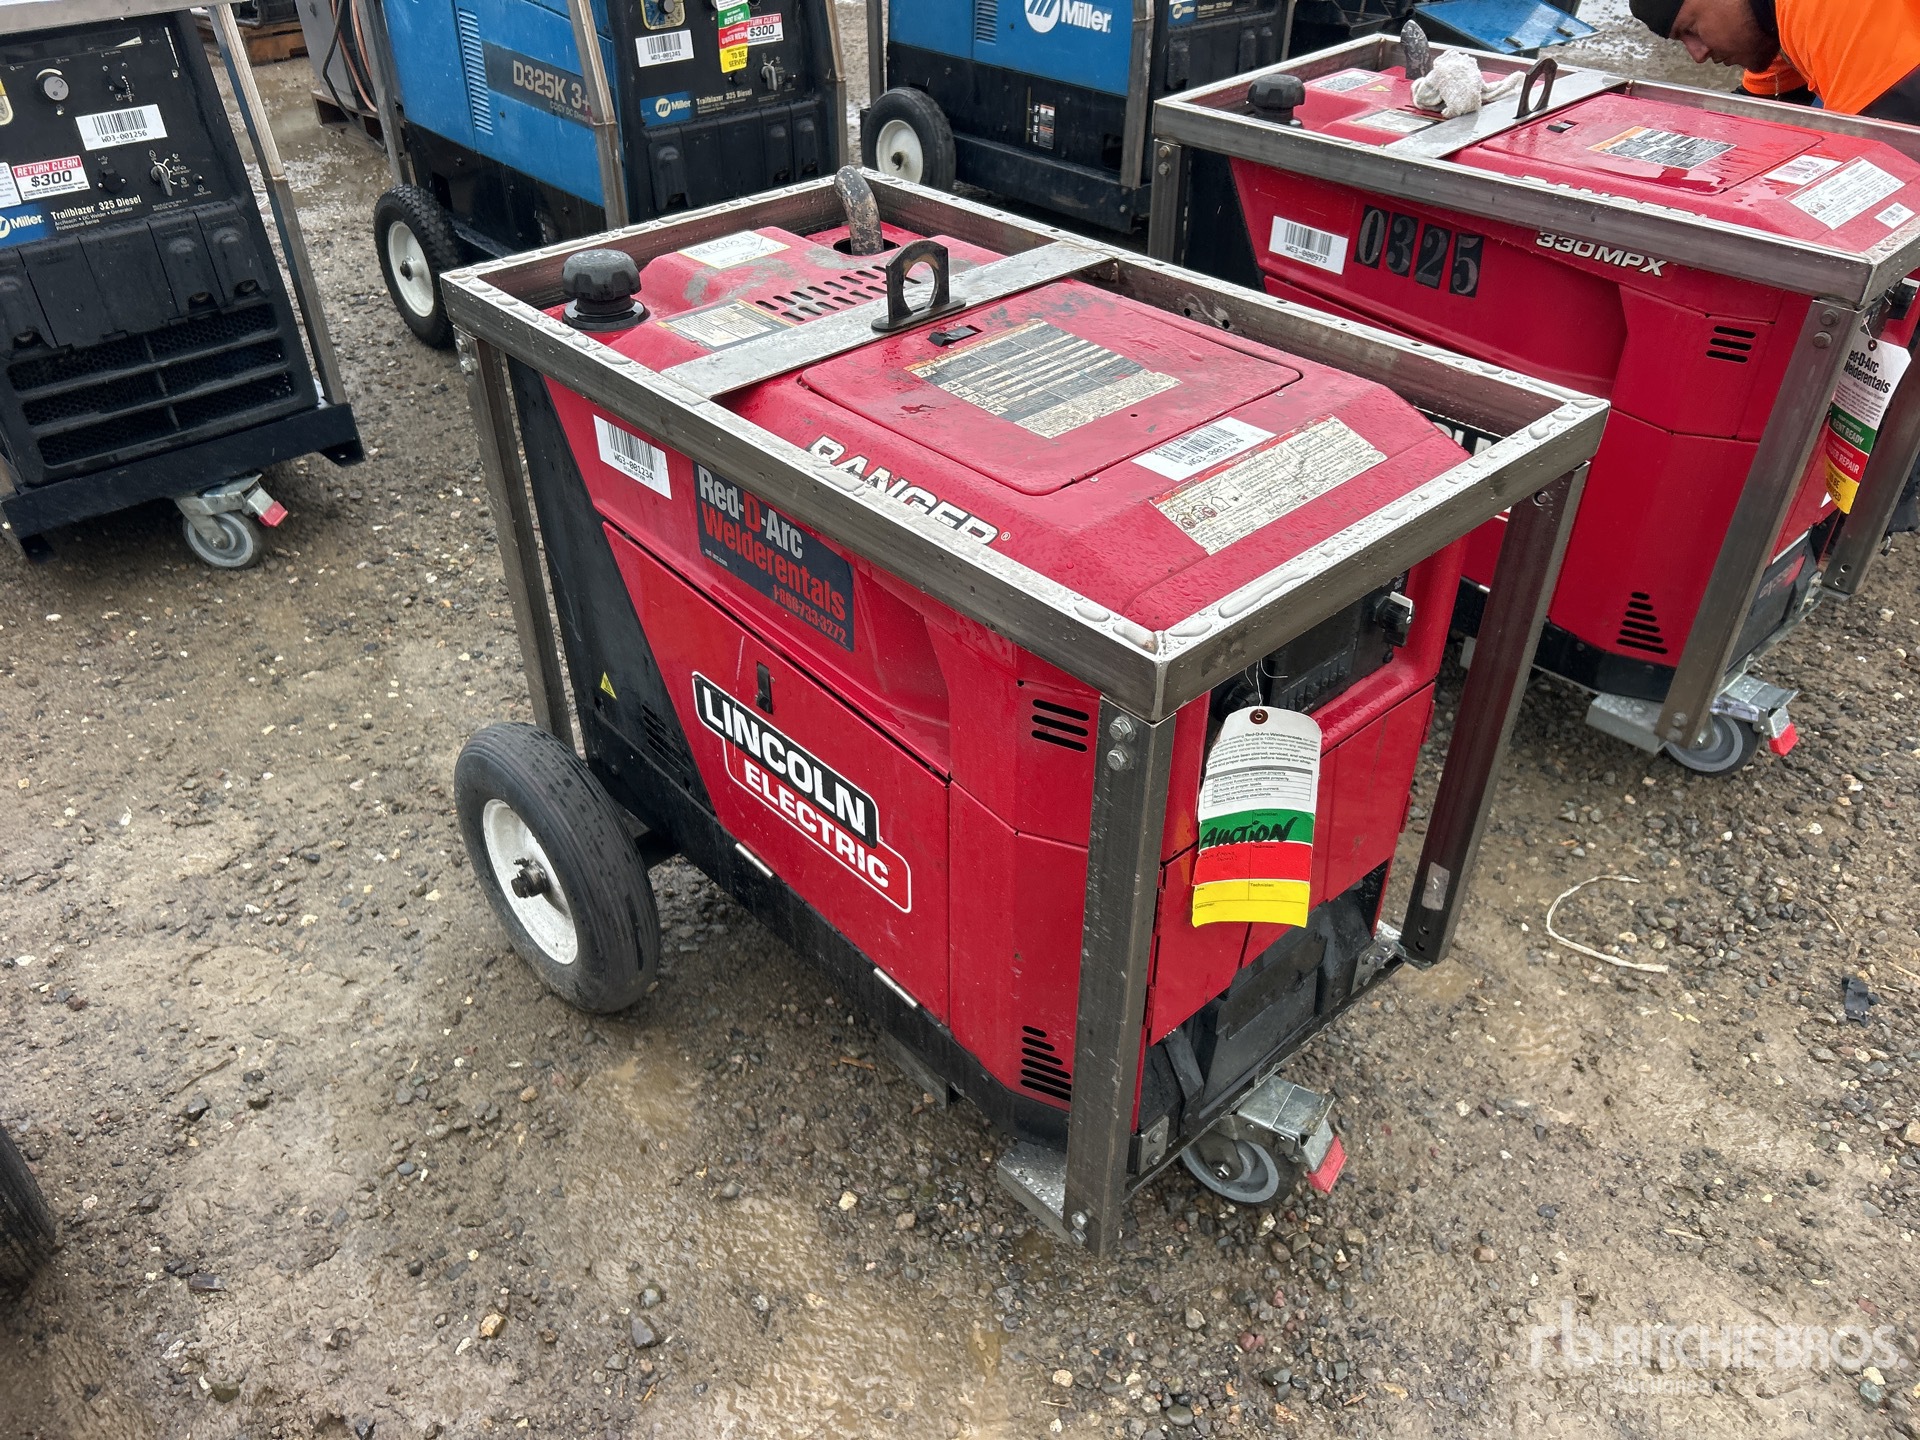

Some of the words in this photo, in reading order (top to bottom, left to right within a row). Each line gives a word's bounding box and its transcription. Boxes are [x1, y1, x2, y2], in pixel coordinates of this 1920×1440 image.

[763, 15, 779, 24] CLEAN
[1061, 0, 1110, 32] Miller
[750, 24, 774, 37] $300
[513, 60, 567, 104] D325K
[671, 100, 692, 110] Miller
[101, 130, 148, 143] WD3-001256
[16, 164, 50, 177] RETURN
[52, 159, 78, 171] CLEAN
[31, 170, 72, 188] $300
[50, 205, 95, 220] Trailblazer
[98, 200, 115, 211] 325
[116, 195, 142, 207] Diesel
[11, 215, 42, 229] Miller
[1285, 244, 1328, 264] WG3-000973
[1358, 209, 1479, 294] 0325
[1848, 350, 1879, 374] ed-D-Arc
[1845, 426, 1864, 446] READY
[1840, 453, 1860, 474] REPAIR
[697, 464, 803, 559] Red-D-Arc
[701, 501, 846, 621] Welderentals
[703, 685, 866, 837] LINCOLN
[744, 758, 889, 888] ELECTRIC
[1200, 816, 1299, 849] AUCTION
